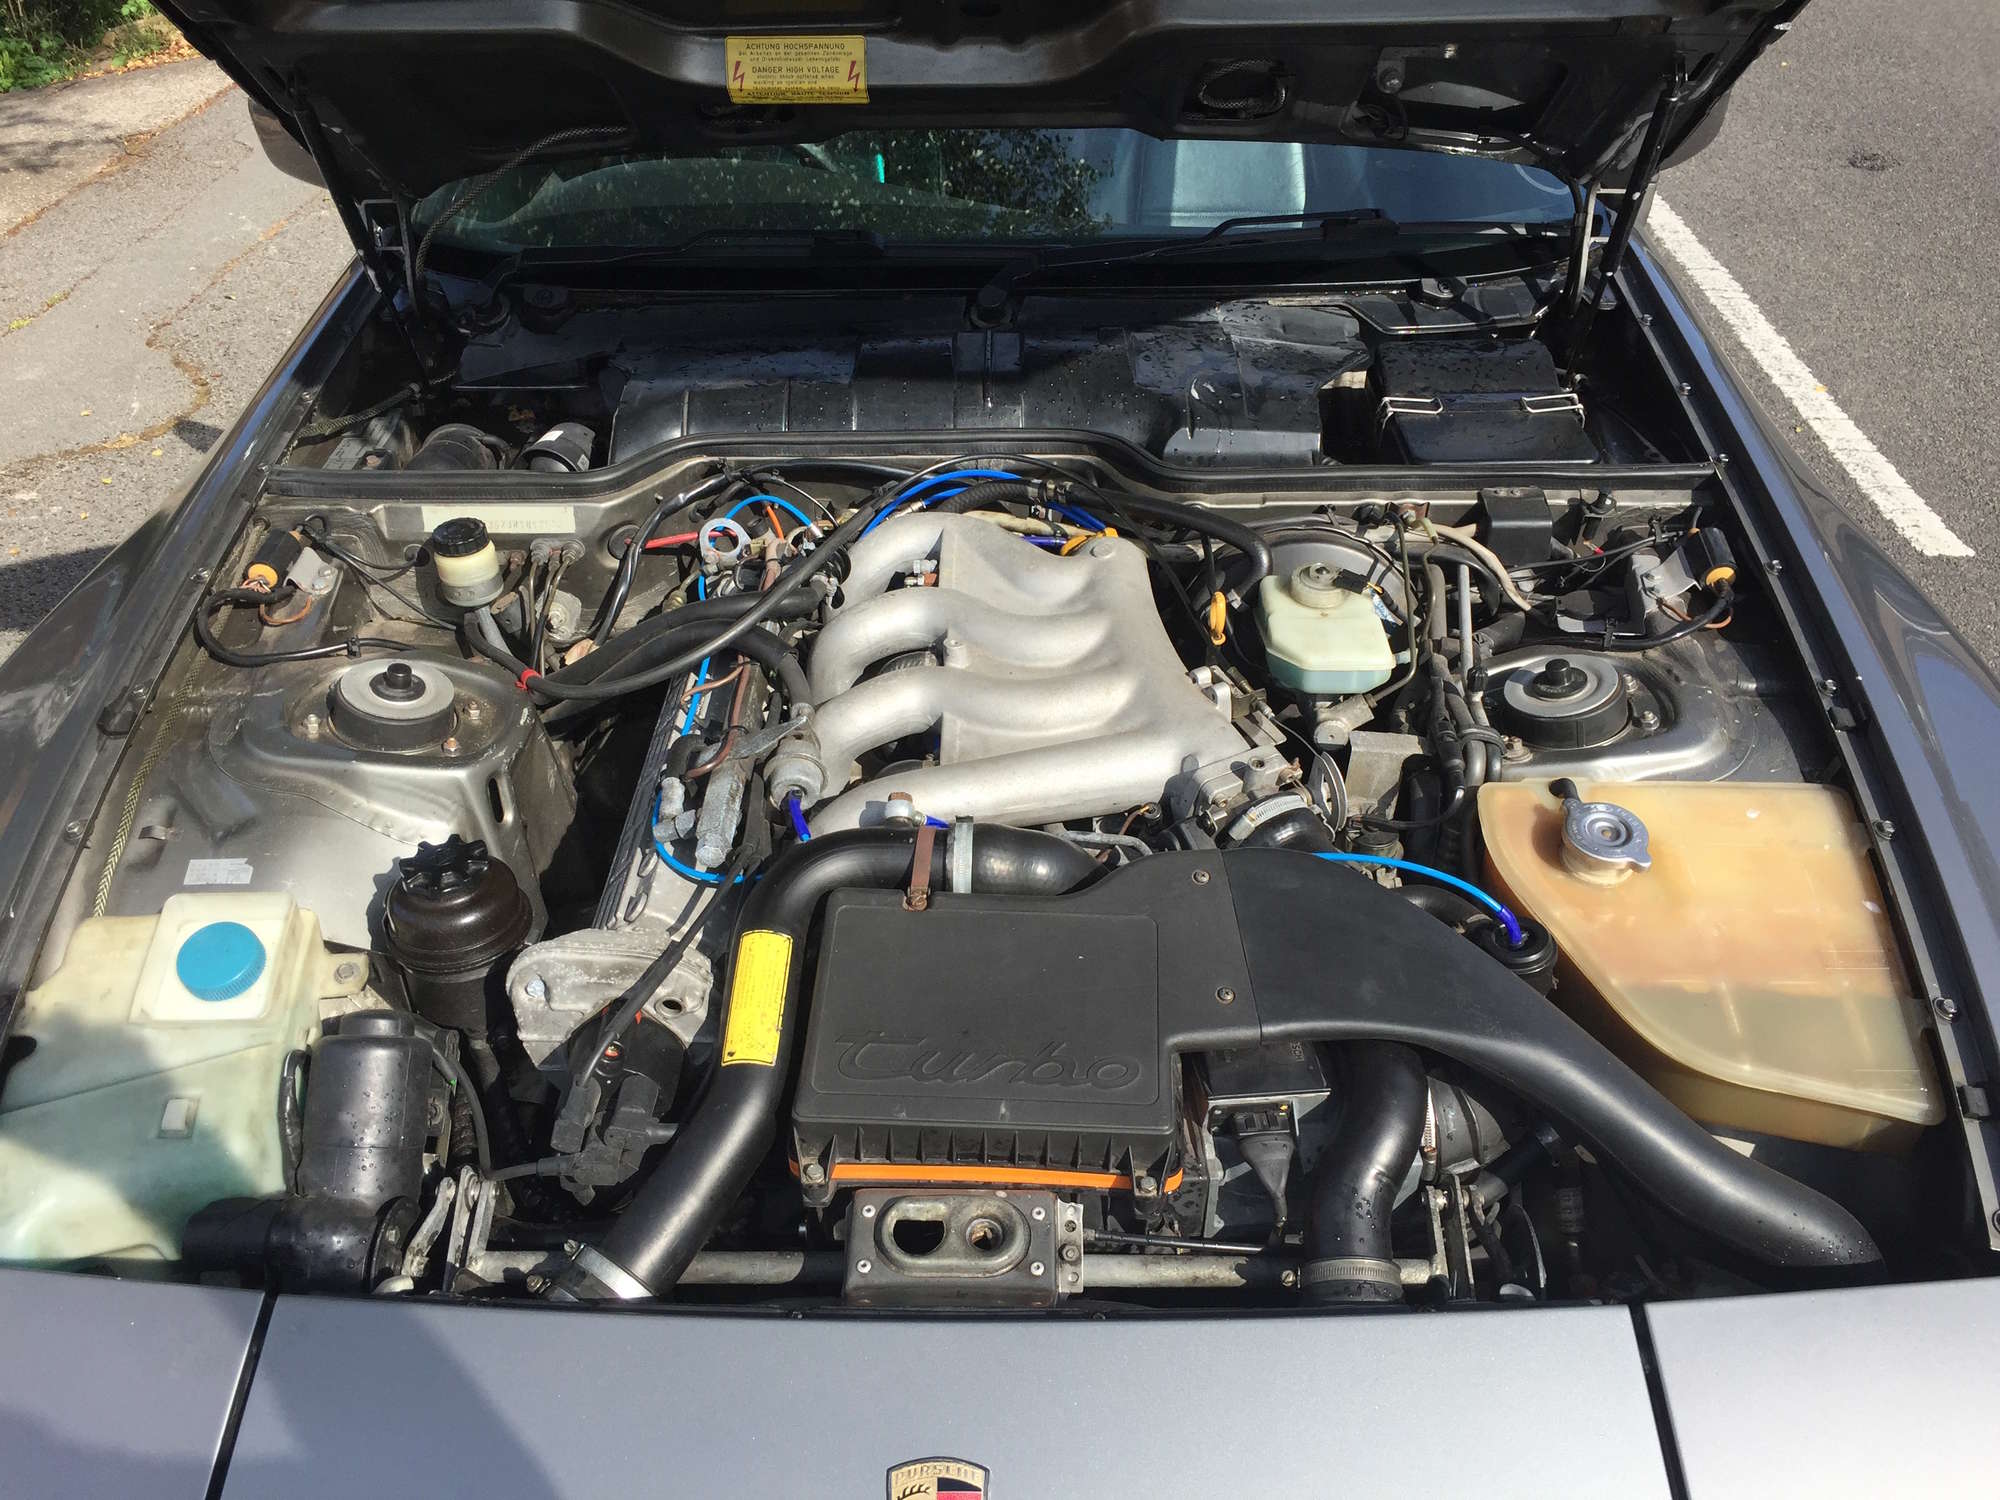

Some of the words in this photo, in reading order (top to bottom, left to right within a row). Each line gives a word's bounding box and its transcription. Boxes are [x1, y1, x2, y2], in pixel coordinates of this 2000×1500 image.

[752, 66, 783, 74] DANGER
[786, 66, 804, 74] HIGH
[806, 66, 840, 74] VOLTAGE
[834, 1031, 1141, 1089] Turbo
